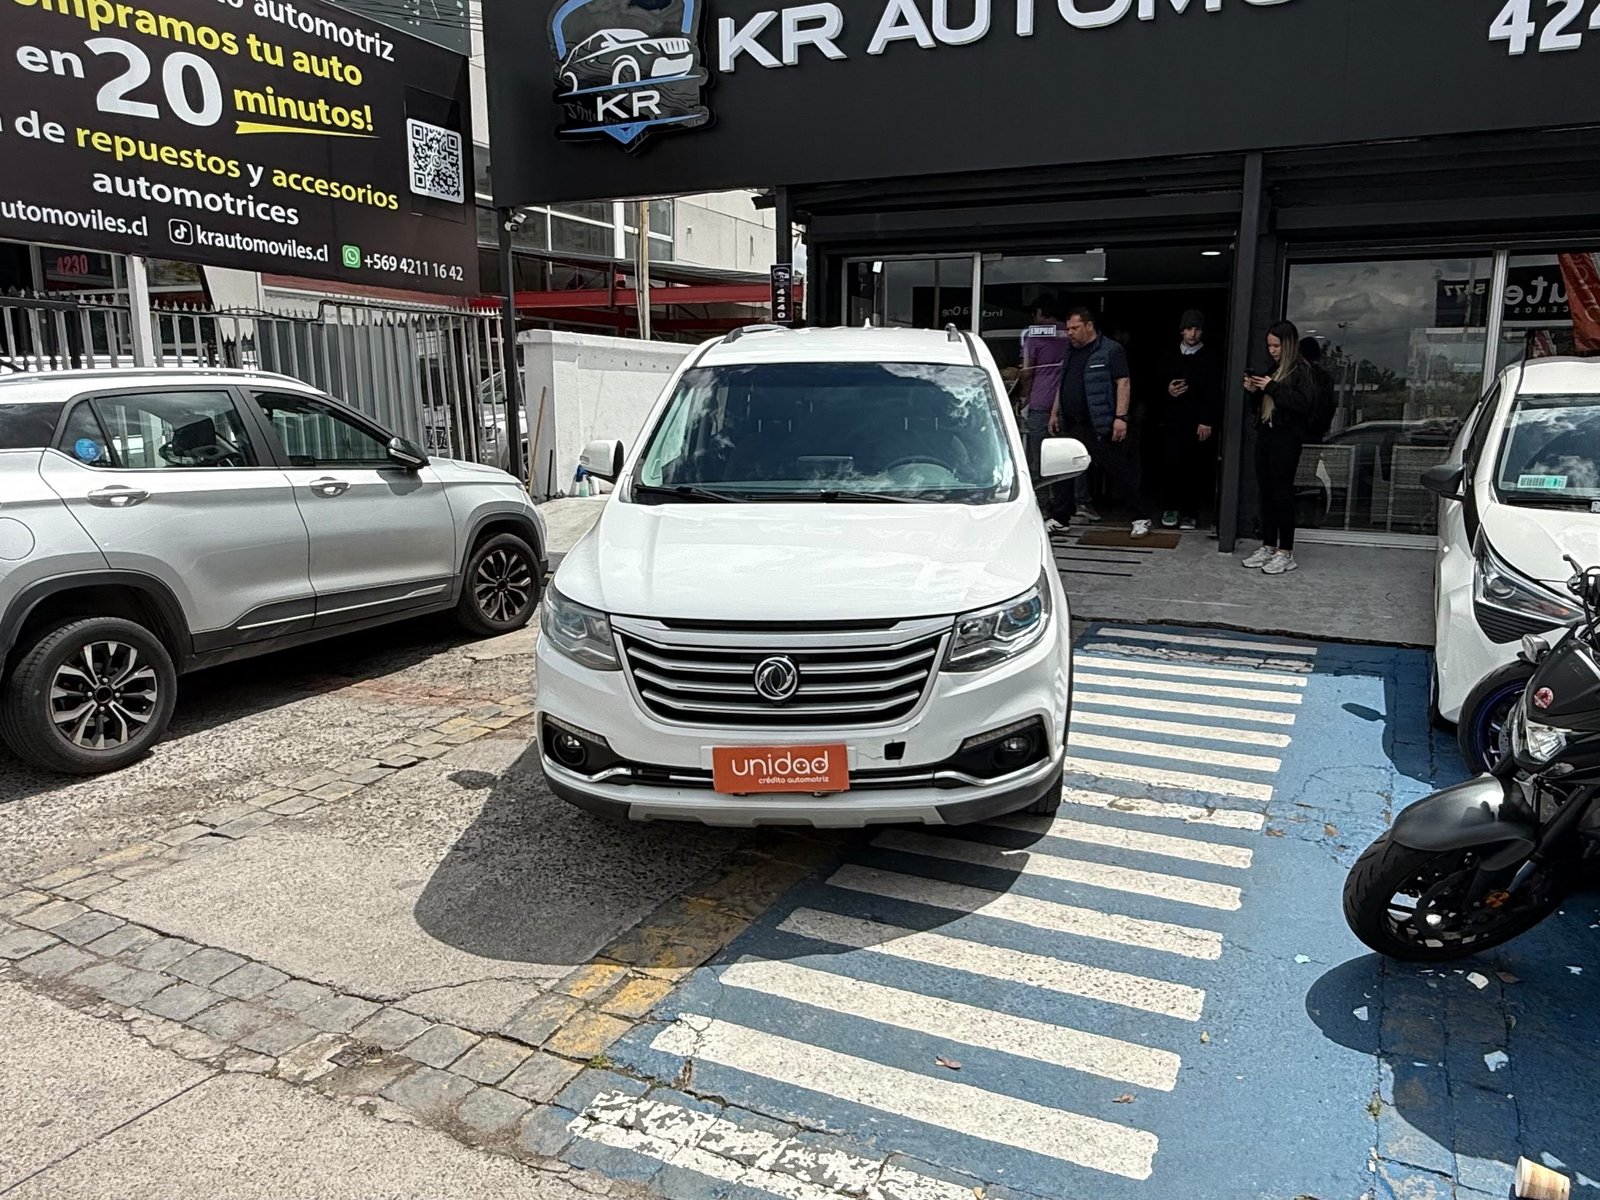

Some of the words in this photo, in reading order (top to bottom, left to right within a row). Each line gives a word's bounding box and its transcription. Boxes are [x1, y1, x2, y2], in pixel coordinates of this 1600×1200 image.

[14, 0, 239, 56] mpramos
[246, 33, 285, 67] tu
[293, 51, 363, 86] auto
[254, 0, 395, 62] automotriz
[718, 2, 848, 73] KR
[866, 0, 1294, 55] AUTO
[1488, 0, 1600, 56] 42
[16, 45, 85, 79] en
[84, 37, 223, 127] 20
[234, 86, 375, 131] minutos!
[596, 90, 662, 122] KR
[14, 110, 66, 144] de
[76, 127, 240, 178] repuestos
[247, 163, 264, 188] y
[272, 168, 399, 210] accesorios
[92, 172, 299, 226] automotrices
[197, 224, 329, 263] krautomoviles.cl
[364, 253, 397, 272] +569
[400, 257, 429, 276] 4211
[731, 750, 829, 776] unidad
[758, 776, 786, 784] crédito
[787, 776, 829, 784] automotriz
